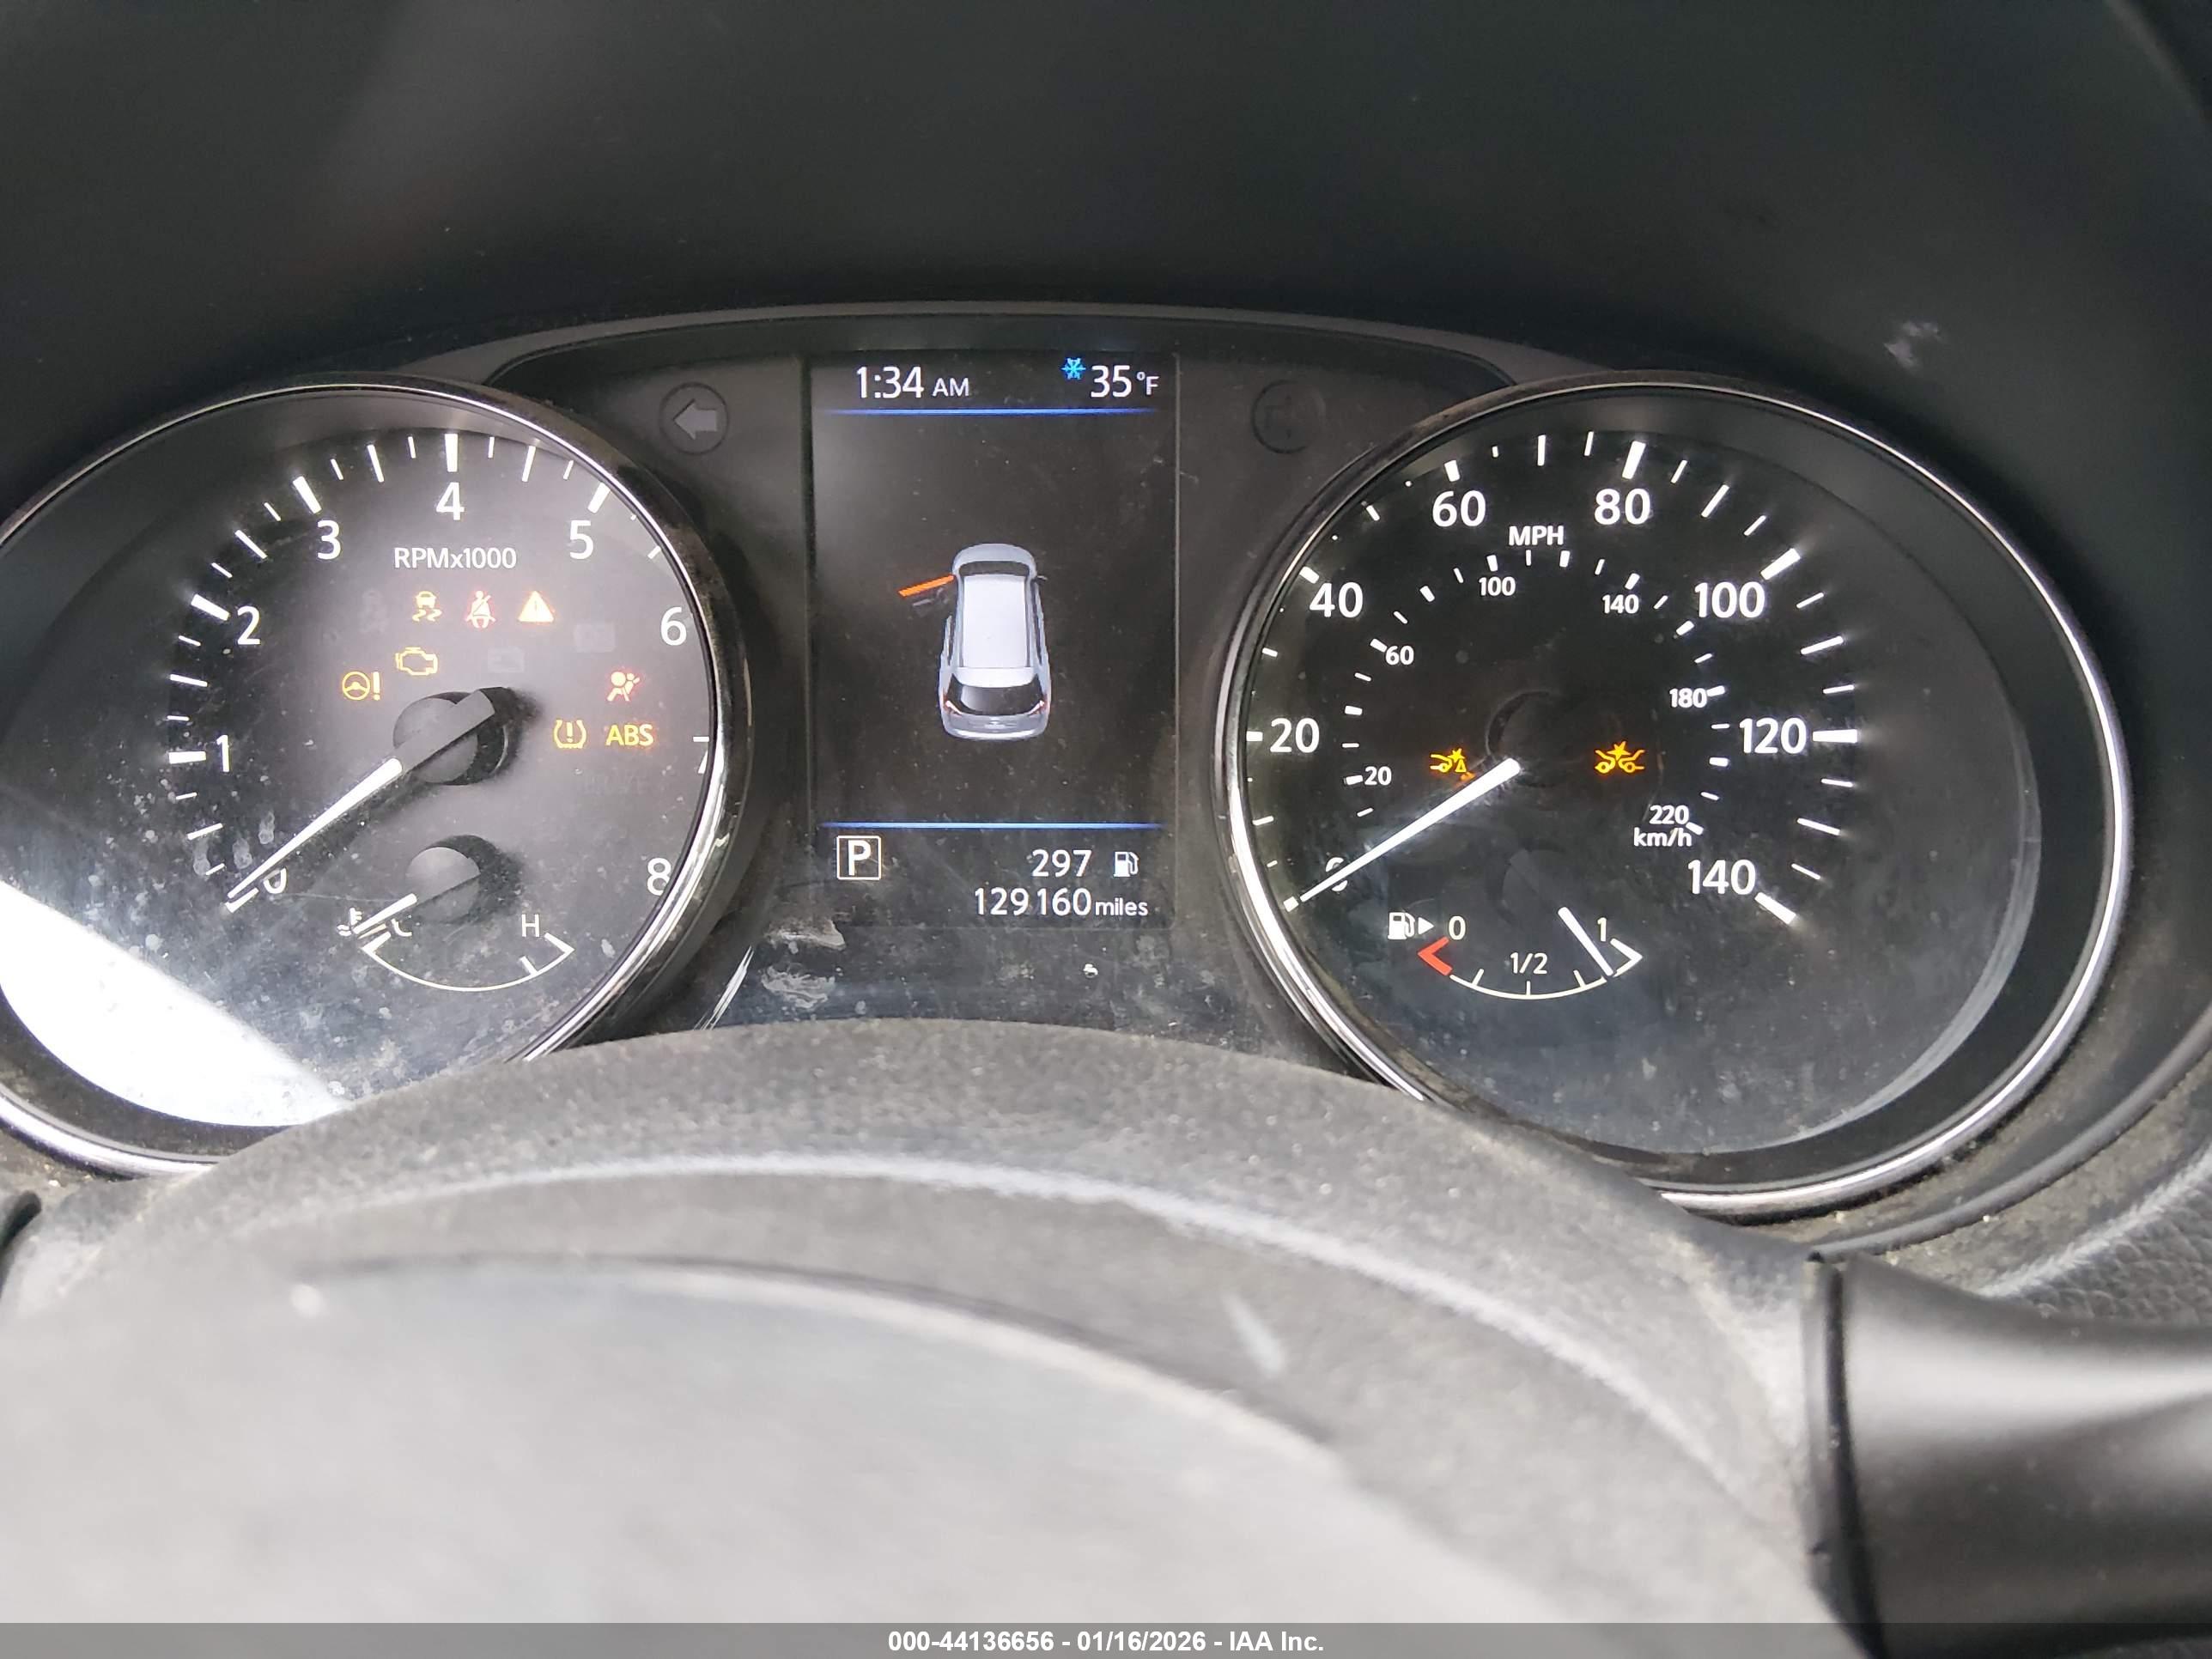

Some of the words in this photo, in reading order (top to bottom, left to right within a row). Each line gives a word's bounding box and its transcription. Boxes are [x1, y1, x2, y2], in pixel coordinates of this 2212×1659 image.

[856, 366, 925, 398] 1:34
[932, 377, 970, 397] AM
[435, 482, 465, 521] 4
[1432, 489, 1486, 527] 60
[1594, 488, 1651, 526] 80
[317, 519, 342, 560] 3
[569, 520, 594, 560] 5
[1508, 525, 1565, 547] MPH
[393, 547, 518, 569] RPMx1000
[1309, 581, 1364, 618] 40
[1478, 576, 1516, 597] 100
[1694, 581, 1766, 618] 100
[1602, 593, 1639, 615] 140
[237, 605, 261, 646] 2
[660, 606, 687, 647] 6
[1385, 645, 1414, 665] 60
[1669, 688, 1707, 708] 180
[604, 723, 656, 747] ABS
[1269, 717, 1321, 753] 20
[1739, 717, 1806, 754] 120
[216, 734, 230, 773] 1
[1364, 766, 1393, 786] 20
[1648, 805, 1690, 826] 220
[1633, 826, 1693, 848] km/h
[847, 839, 872, 877] P
[1031, 848, 1092, 878] 297
[647, 857, 672, 896] 8
[1687, 860, 1756, 896] 140
[1094, 897, 1149, 916] miles
[521, 914, 540, 938] H
[1448, 915, 1467, 940] 0
[1597, 917, 1607, 941] 1
[1510, 951, 1548, 975] 1/2
